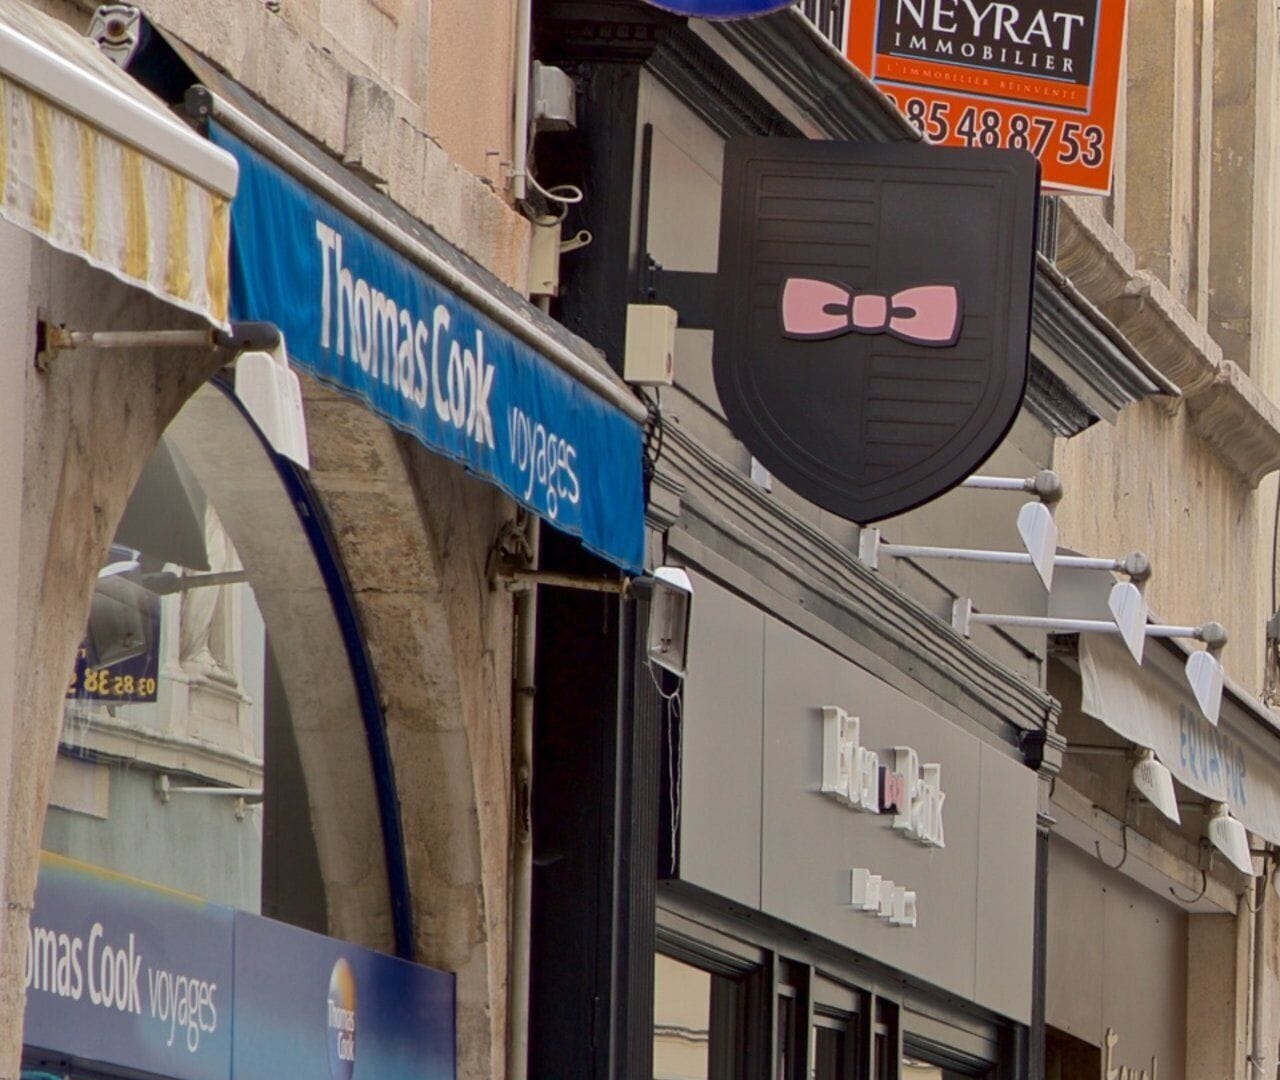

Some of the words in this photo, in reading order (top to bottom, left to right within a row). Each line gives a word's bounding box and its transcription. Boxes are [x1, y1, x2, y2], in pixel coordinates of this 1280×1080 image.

[894, 32, 1075, 73] IMMOBILIER
[895, 0, 1084, 50] NEYRAT
[904, 97, 950, 144] 85
[955, 105, 1002, 149] 48
[1006, 113, 1055, 160] 87
[1057, 120, 1105, 168] 53
[316, 220, 428, 409] Thomas
[431, 304, 495, 450] Cook
[507, 406, 580, 519] voyages
[88, 922, 142, 1014] Cook
[148, 967, 217, 1052] voyages
